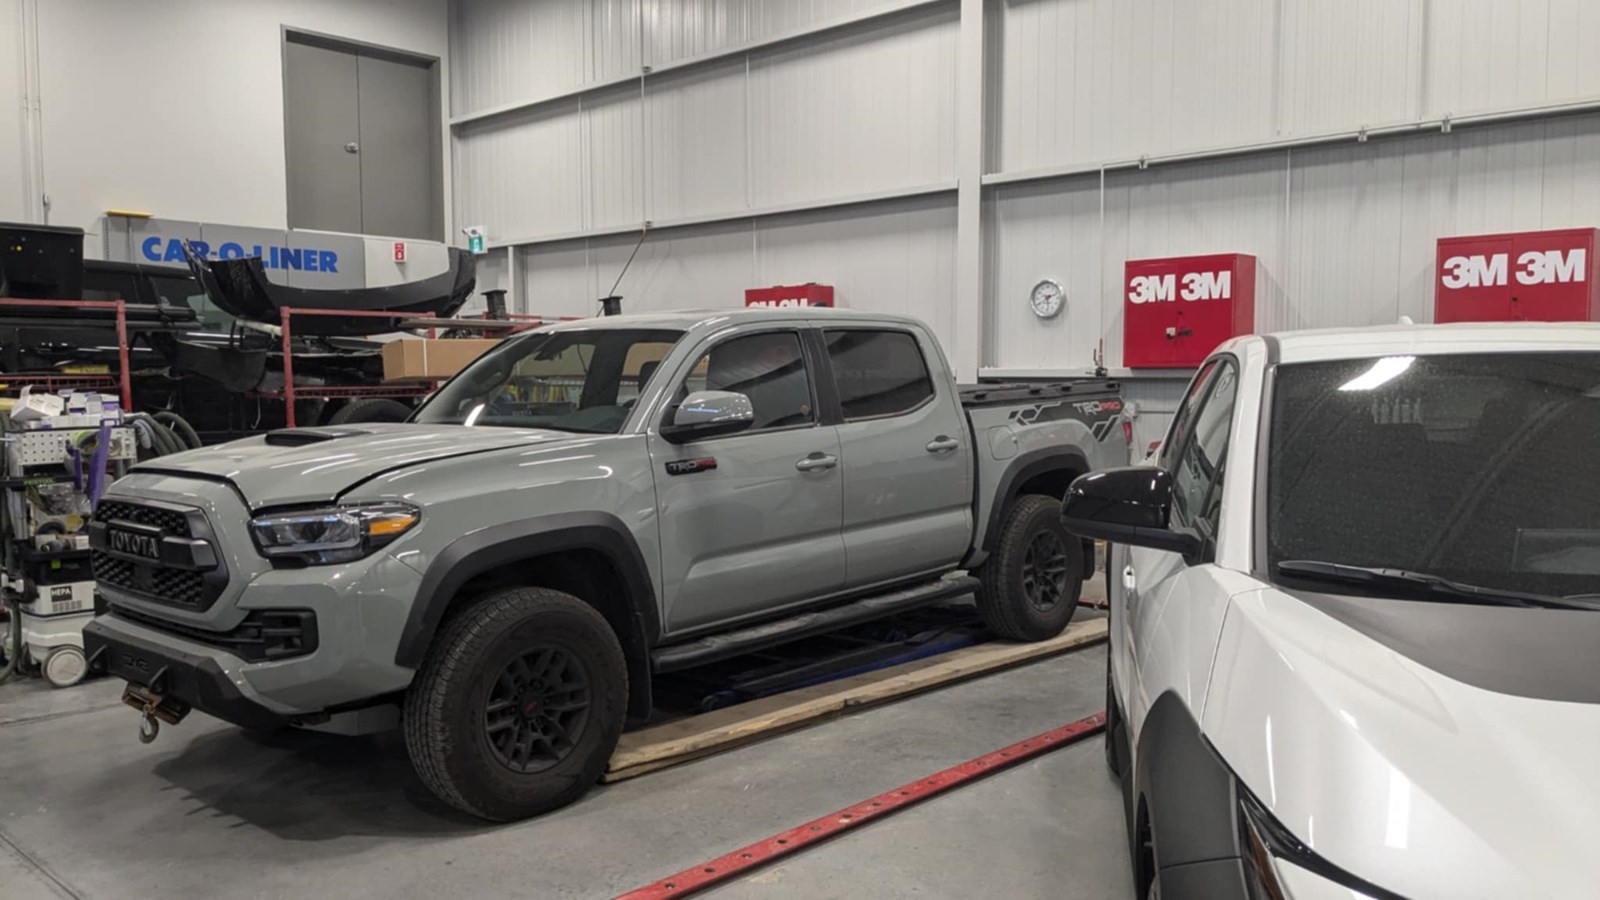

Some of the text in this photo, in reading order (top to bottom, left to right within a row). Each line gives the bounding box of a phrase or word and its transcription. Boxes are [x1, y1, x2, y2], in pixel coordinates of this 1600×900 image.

[1442, 248, 1586, 289] 3M 3M
[1128, 270, 1232, 304] 3M 3M
[109, 529, 159, 558] TOYOTA
[51, 588, 72, 597] HEPA
